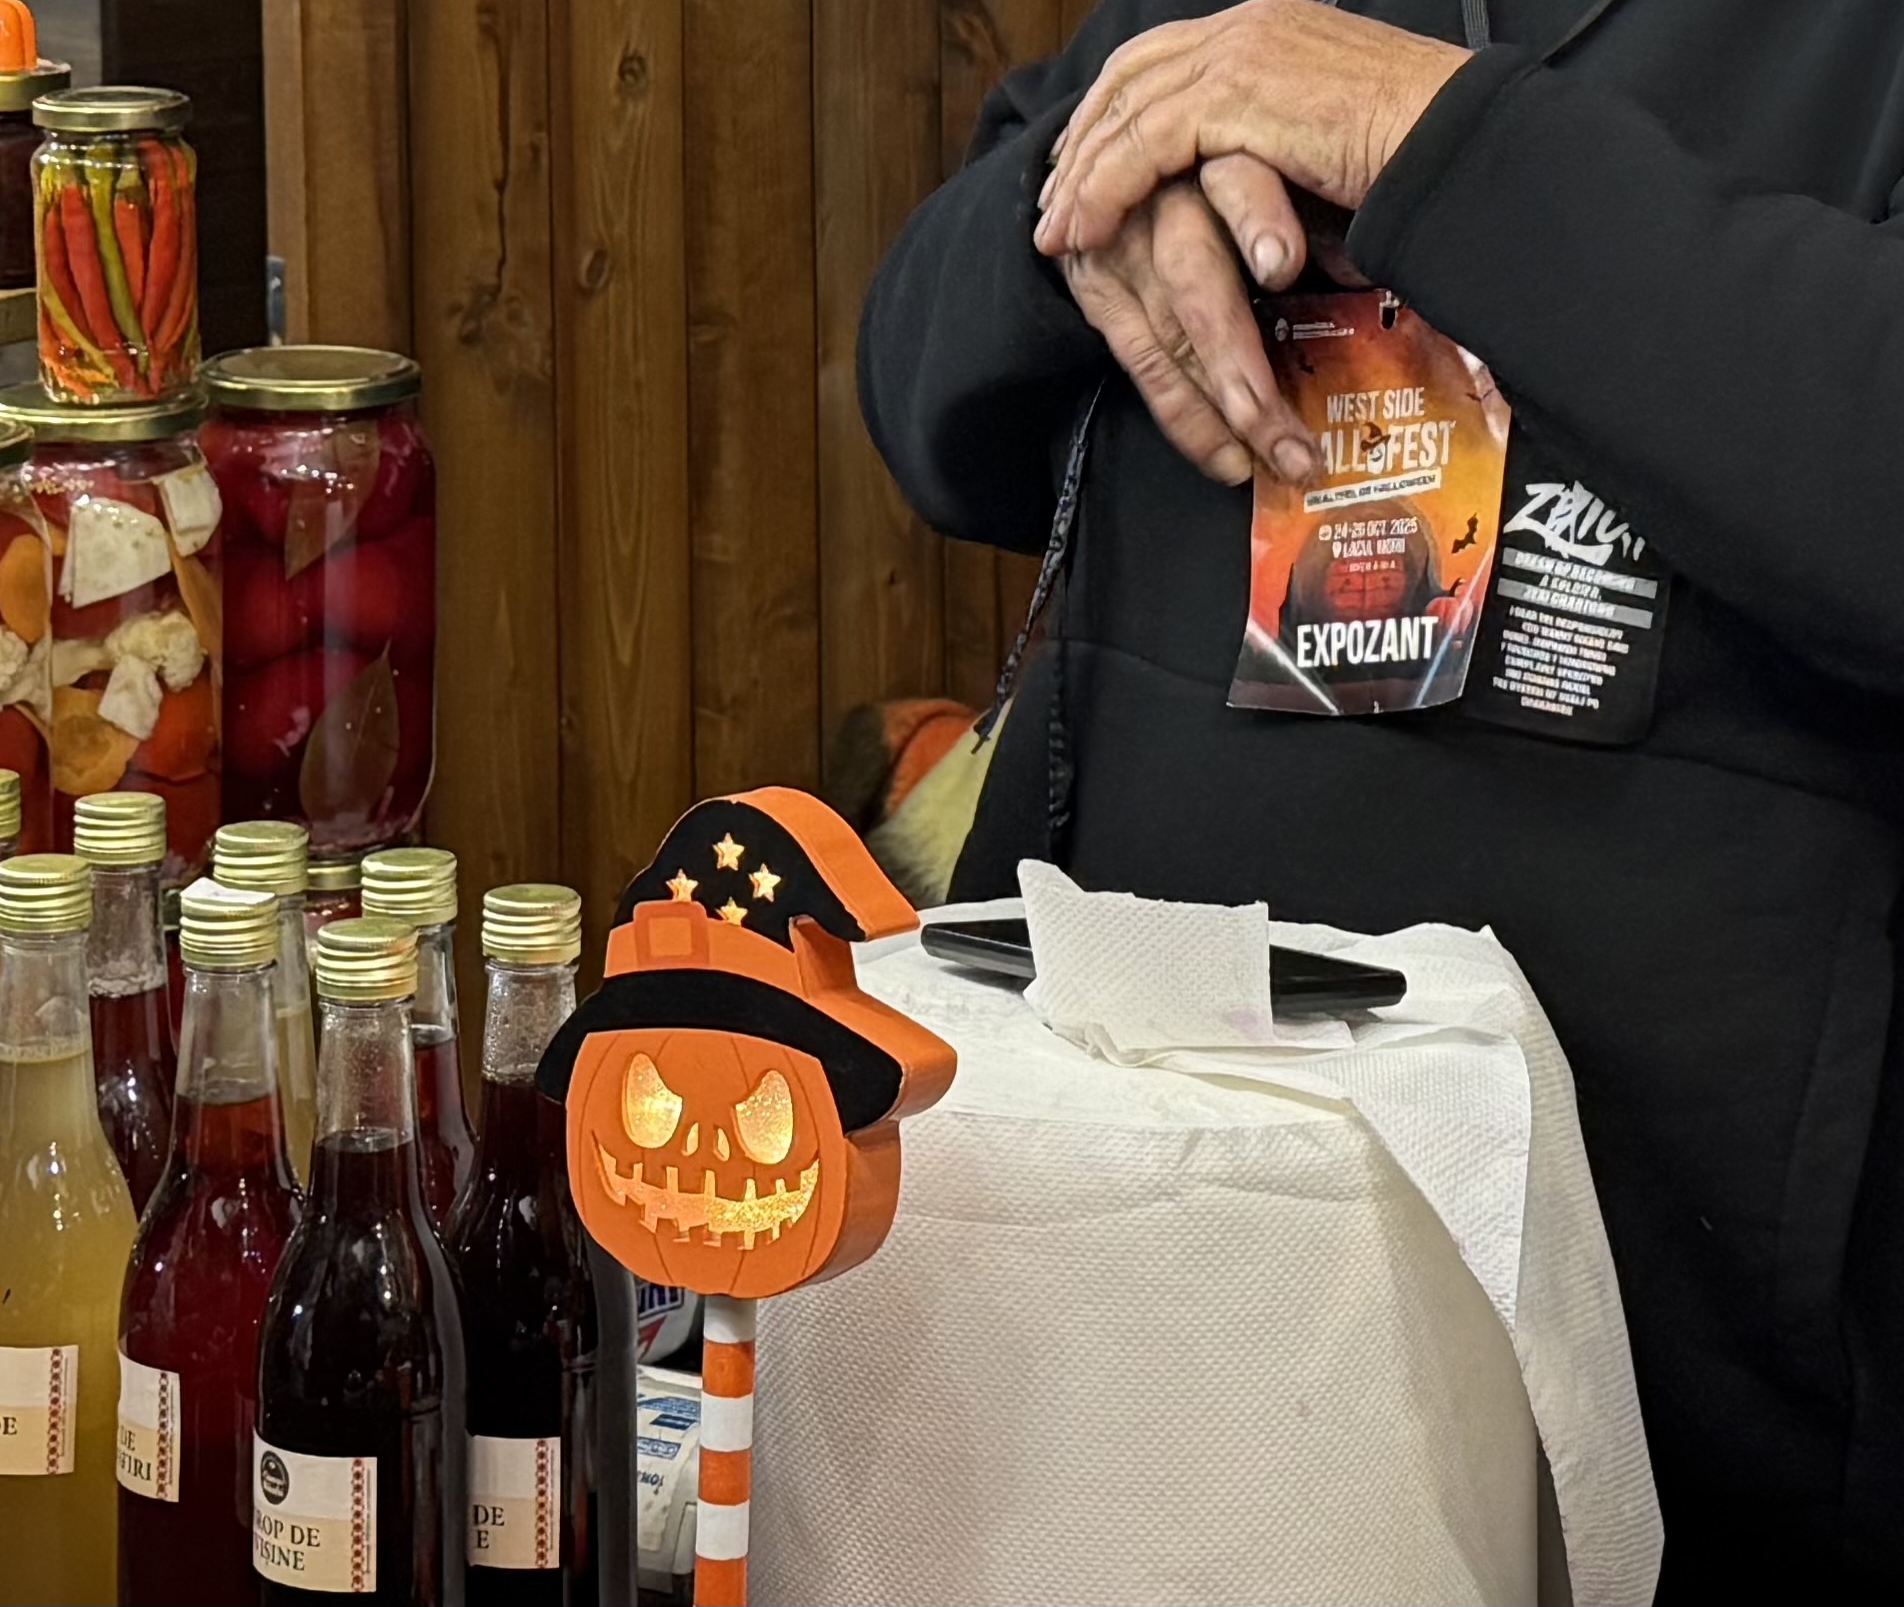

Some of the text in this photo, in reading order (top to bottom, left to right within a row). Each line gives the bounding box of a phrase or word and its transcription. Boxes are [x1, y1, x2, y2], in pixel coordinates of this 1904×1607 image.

[1326, 386, 1426, 423] WEST SIDE
[1296, 615, 1439, 668] EXPOZANT
[472, 1503, 505, 1527] DE
[289, 1524, 321, 1548] DE
